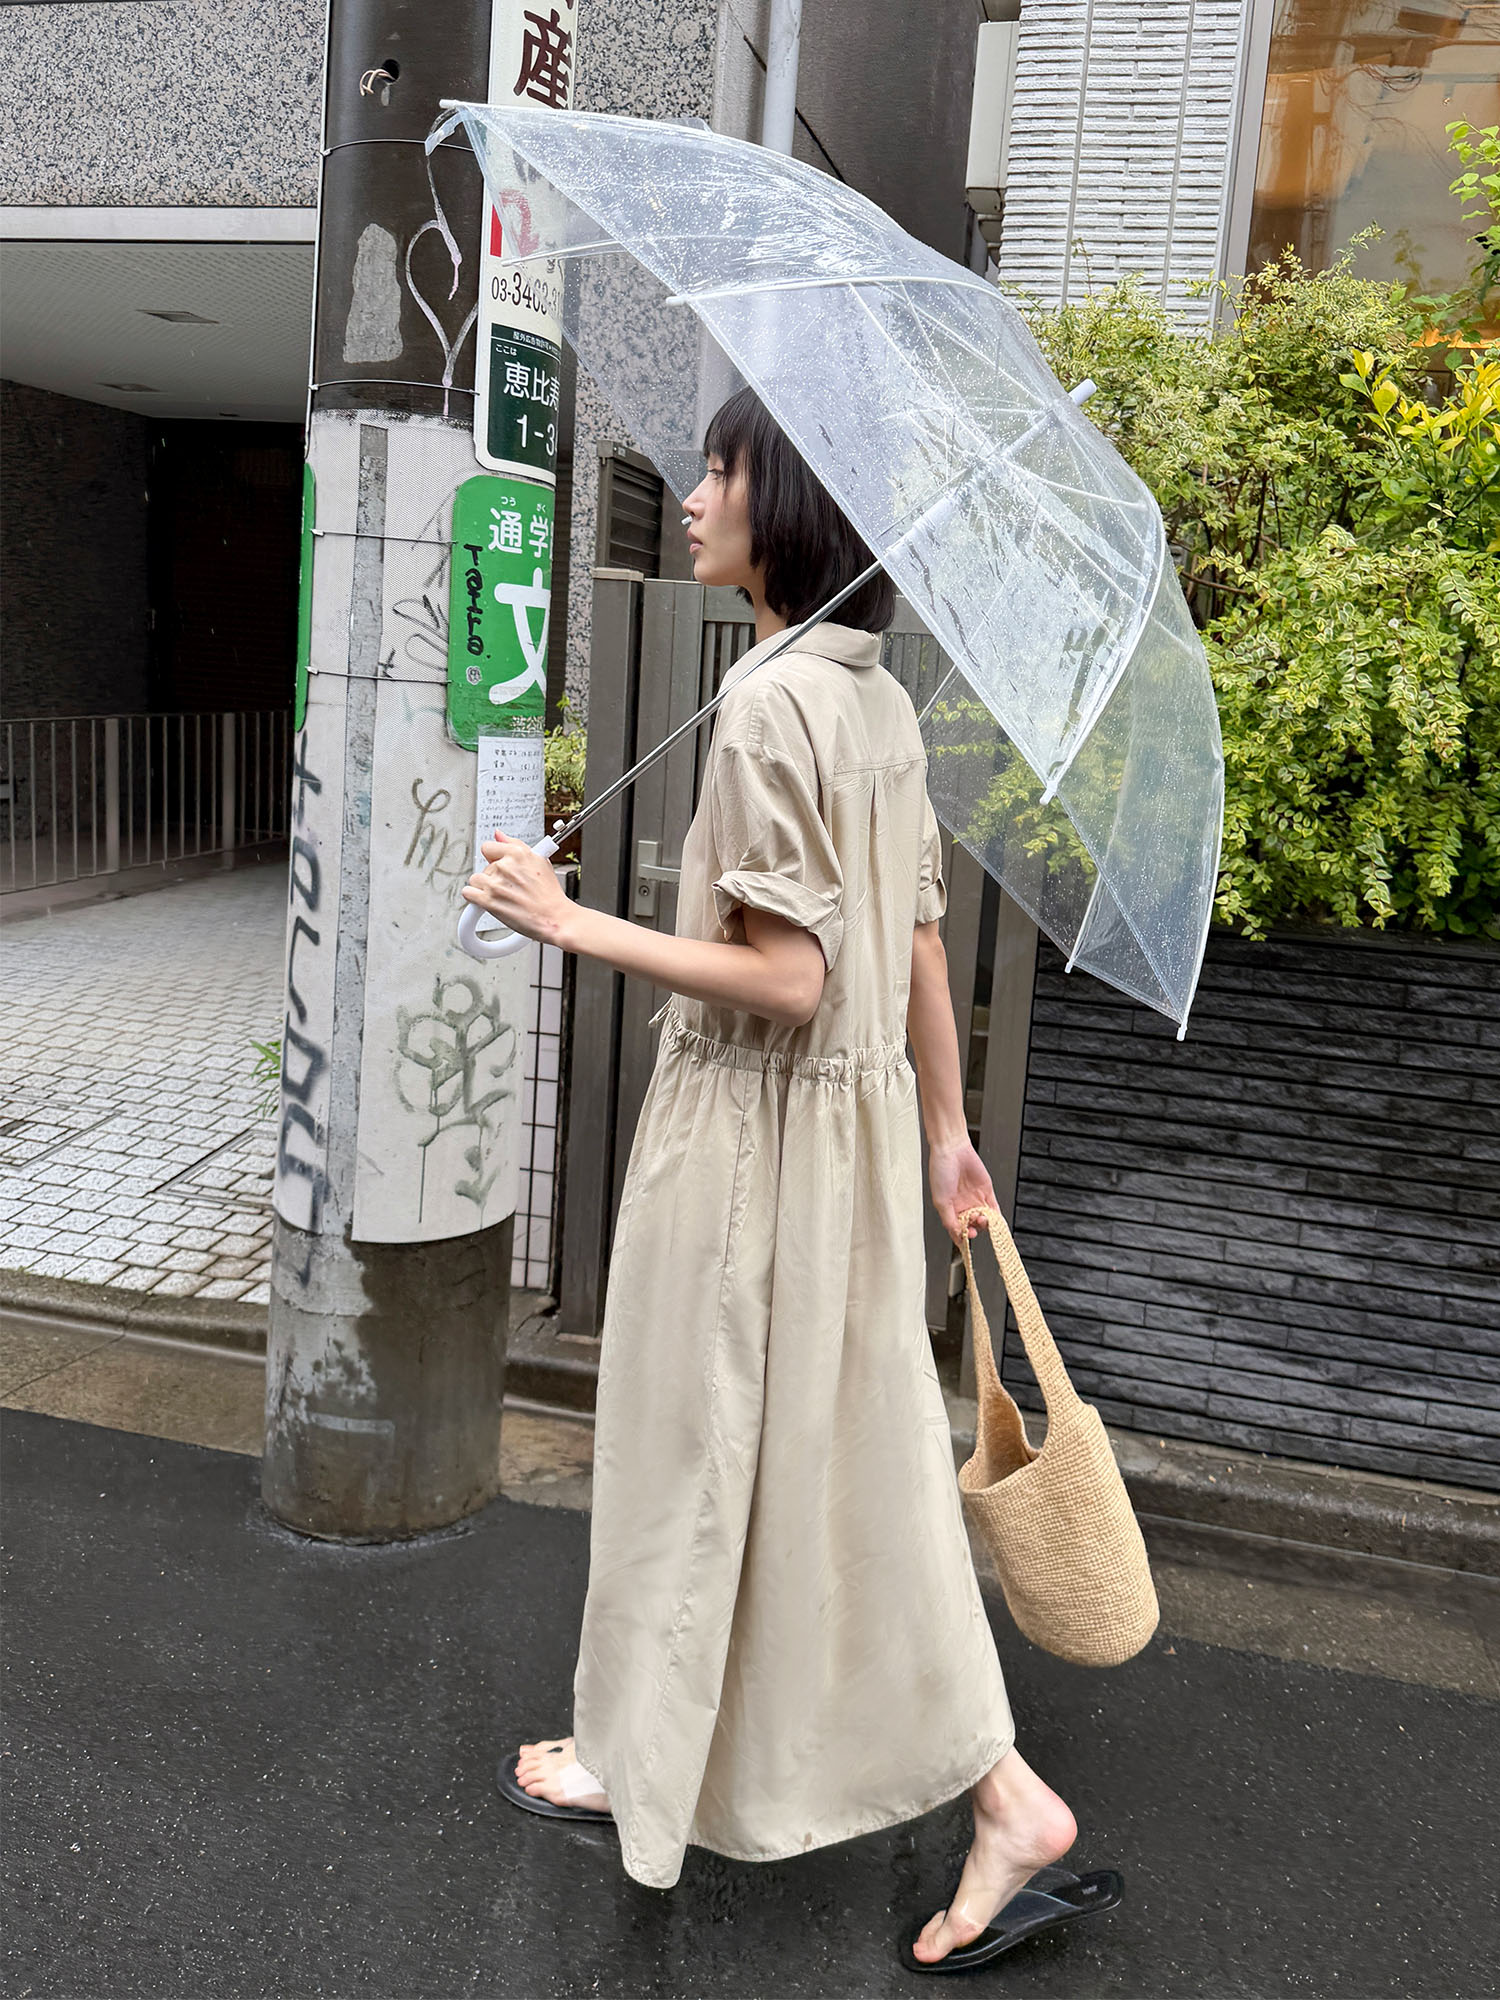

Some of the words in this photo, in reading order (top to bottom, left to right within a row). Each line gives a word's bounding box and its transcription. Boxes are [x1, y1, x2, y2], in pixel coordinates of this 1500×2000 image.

[513, 0, 574, 110] 産
[495, 343, 518, 356] ここは
[516, 414, 556, 457] 1-3
[500, 496, 517, 507] つう
[488, 507, 554, 560] 通学
